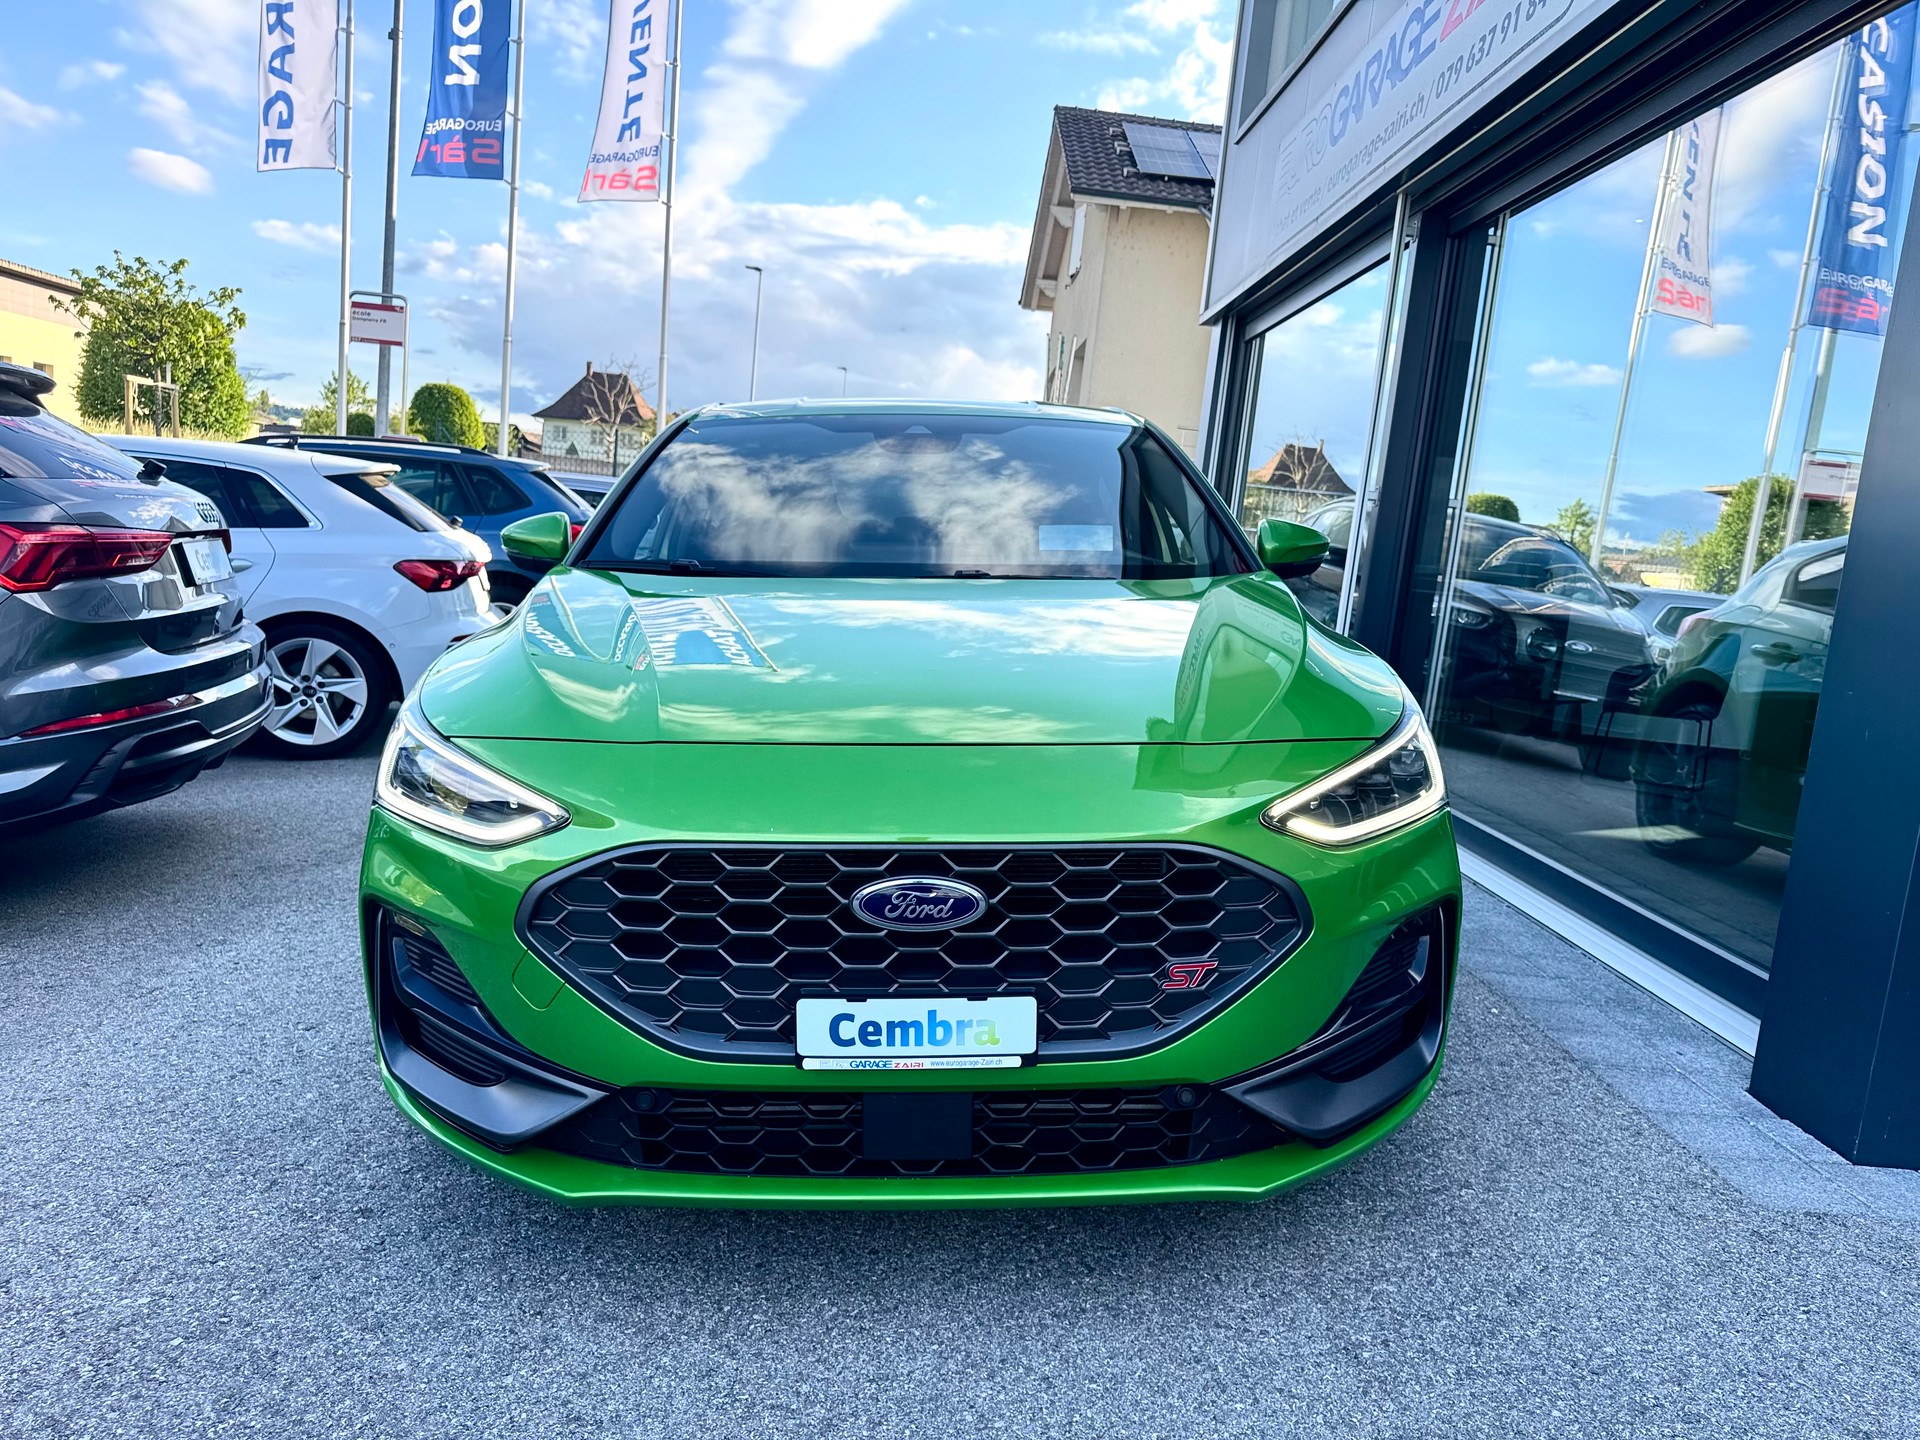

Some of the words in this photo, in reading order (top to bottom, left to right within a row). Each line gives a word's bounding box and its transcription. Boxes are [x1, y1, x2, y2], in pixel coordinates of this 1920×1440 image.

[1326, 91, 1425, 193] eurogarage-zairi.ch
[1435, 54, 1464, 99] 079
[1465, 22, 1498, 73] 637
[1500, 2, 1521, 45] 91
[884, 891, 955, 919] Ford
[1162, 961, 1218, 989] ST
[828, 1009, 1000, 1048] Cembra
